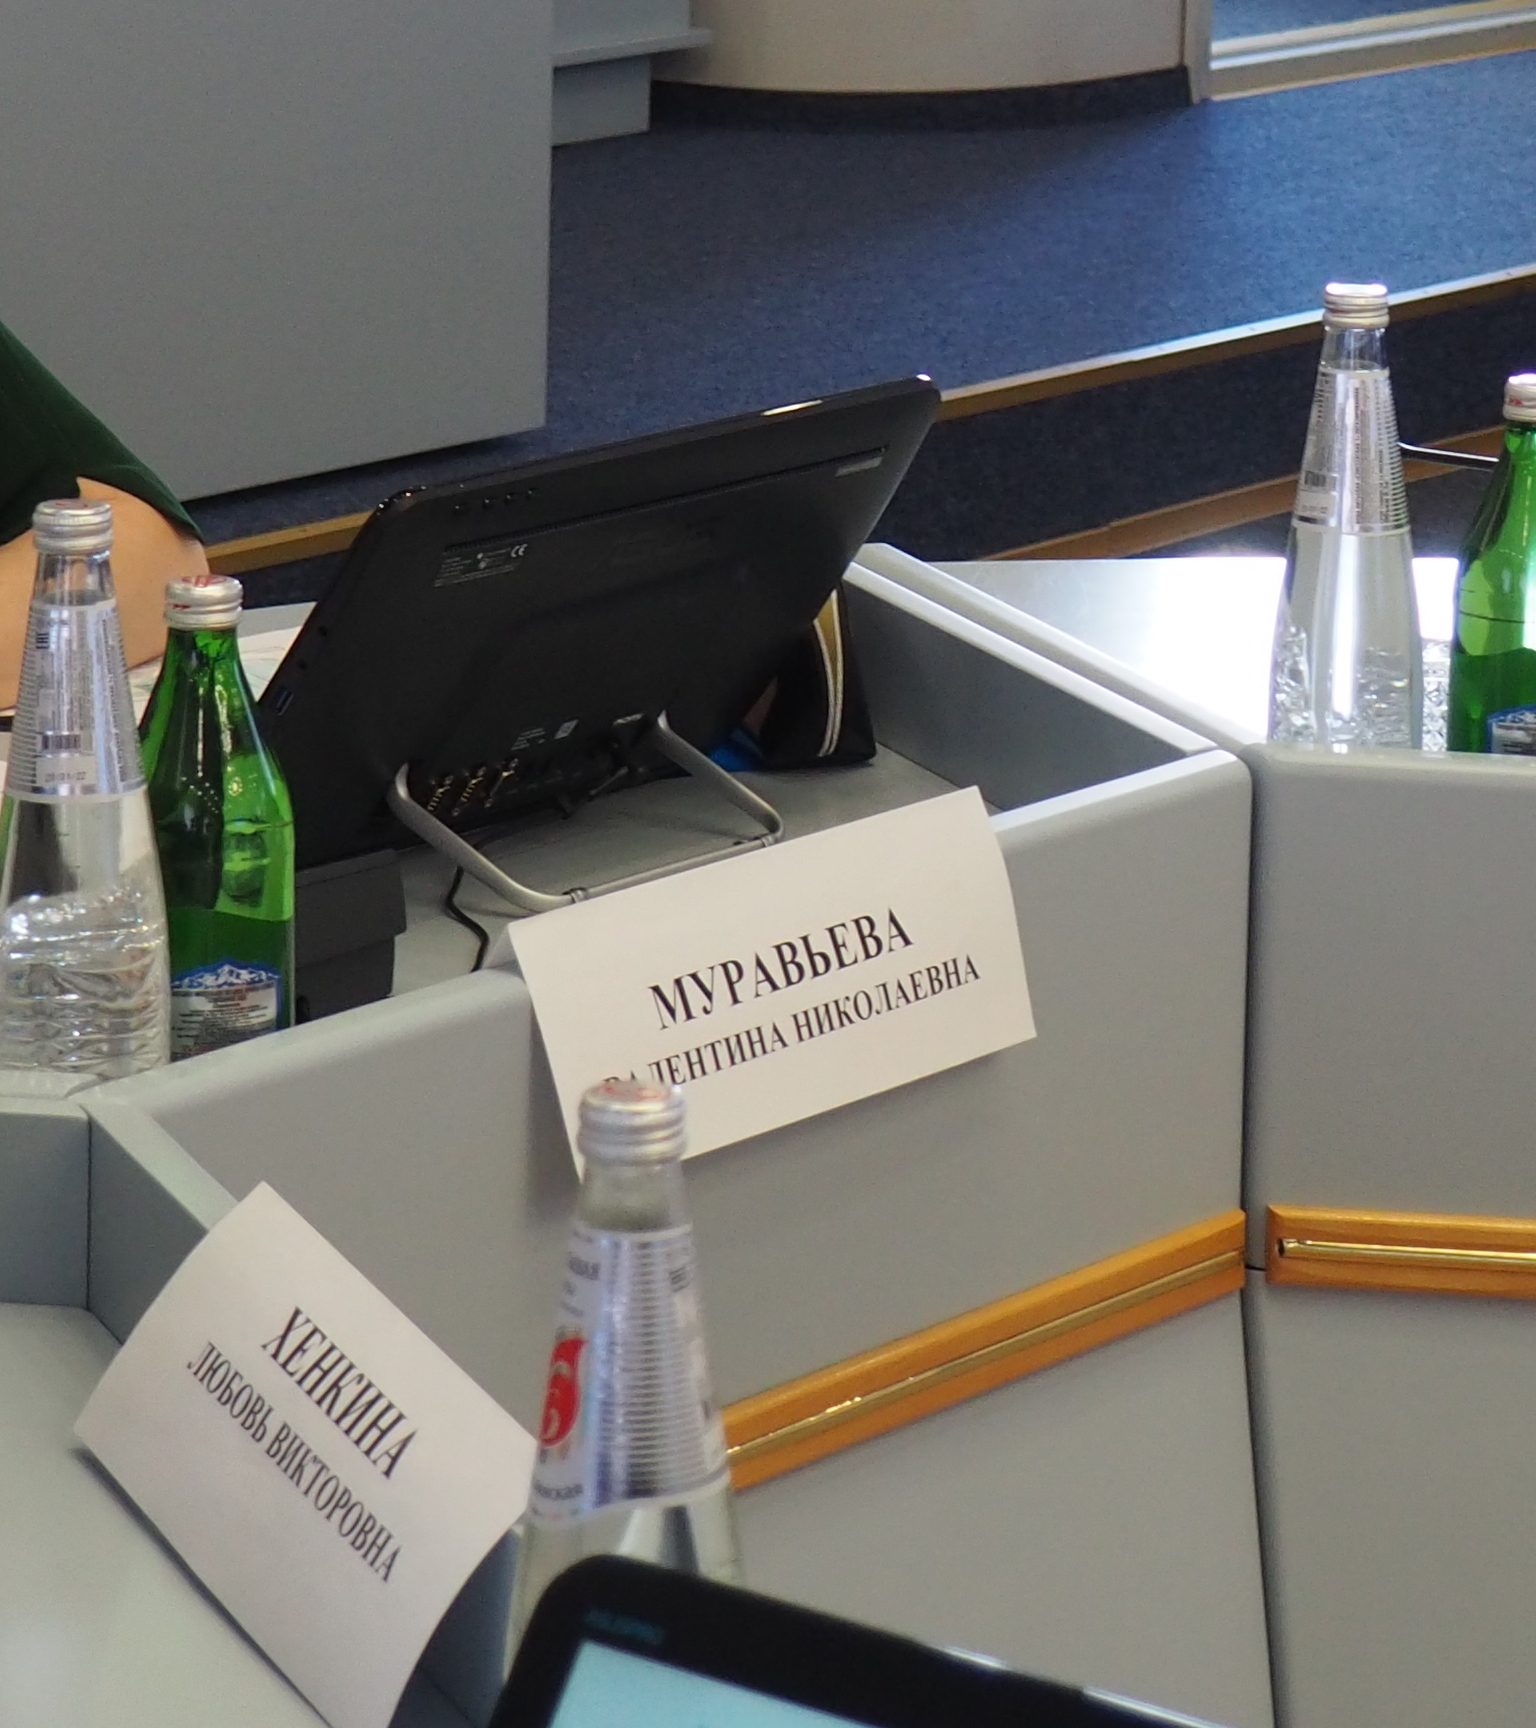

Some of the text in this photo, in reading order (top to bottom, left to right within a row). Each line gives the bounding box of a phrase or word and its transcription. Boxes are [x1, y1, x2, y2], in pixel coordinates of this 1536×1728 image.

[603, 952, 982, 1088] ЛЕНТИНА НИКОЛАЕВНА
[647, 907, 915, 1032] МУРАВЬЕВА
[185, 1340, 404, 1584] ЛЮБОВЬ ВИКТОРОВНА
[260, 1306, 422, 1481] ХЕНКИНА
